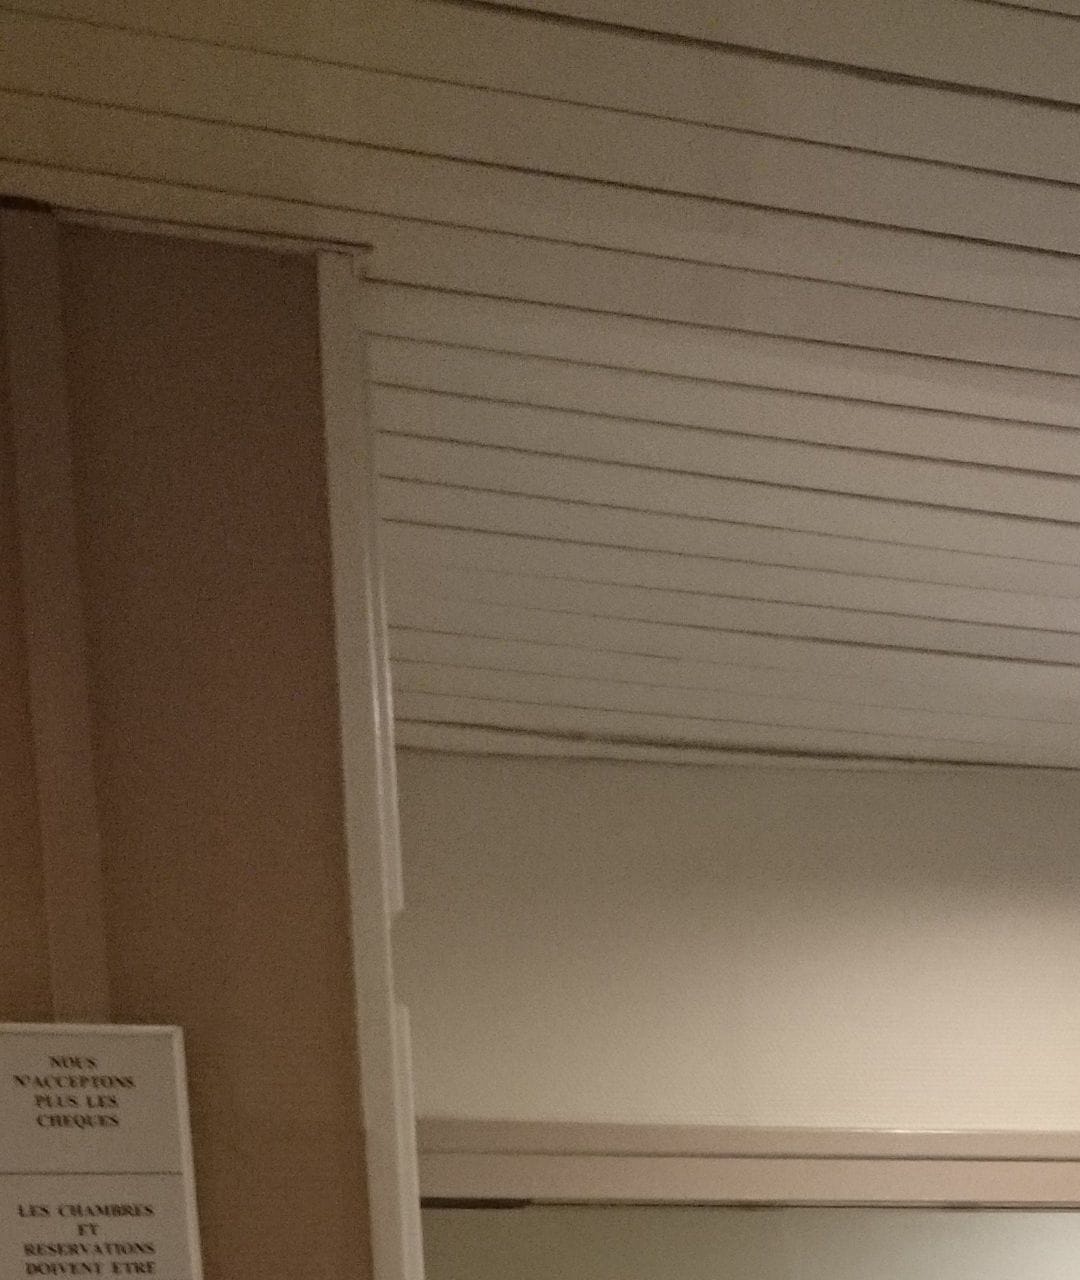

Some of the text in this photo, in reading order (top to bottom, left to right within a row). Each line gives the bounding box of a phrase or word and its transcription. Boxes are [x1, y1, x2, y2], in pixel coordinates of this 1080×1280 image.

[49, 1055, 97, 1069] NOUS
[12, 1074, 136, 1088] N'ACCEPTONS
[34, 1094, 118, 1108] PLUS LES
[36, 1114, 119, 1129] CHEQUES
[18, 1203, 155, 1217] LES CHAMBRES
[77, 1222, 100, 1236] ET
[24, 1242, 156, 1256] RESERVATIONS
[25, 1261, 155, 1275] DOIVENT ETRE
